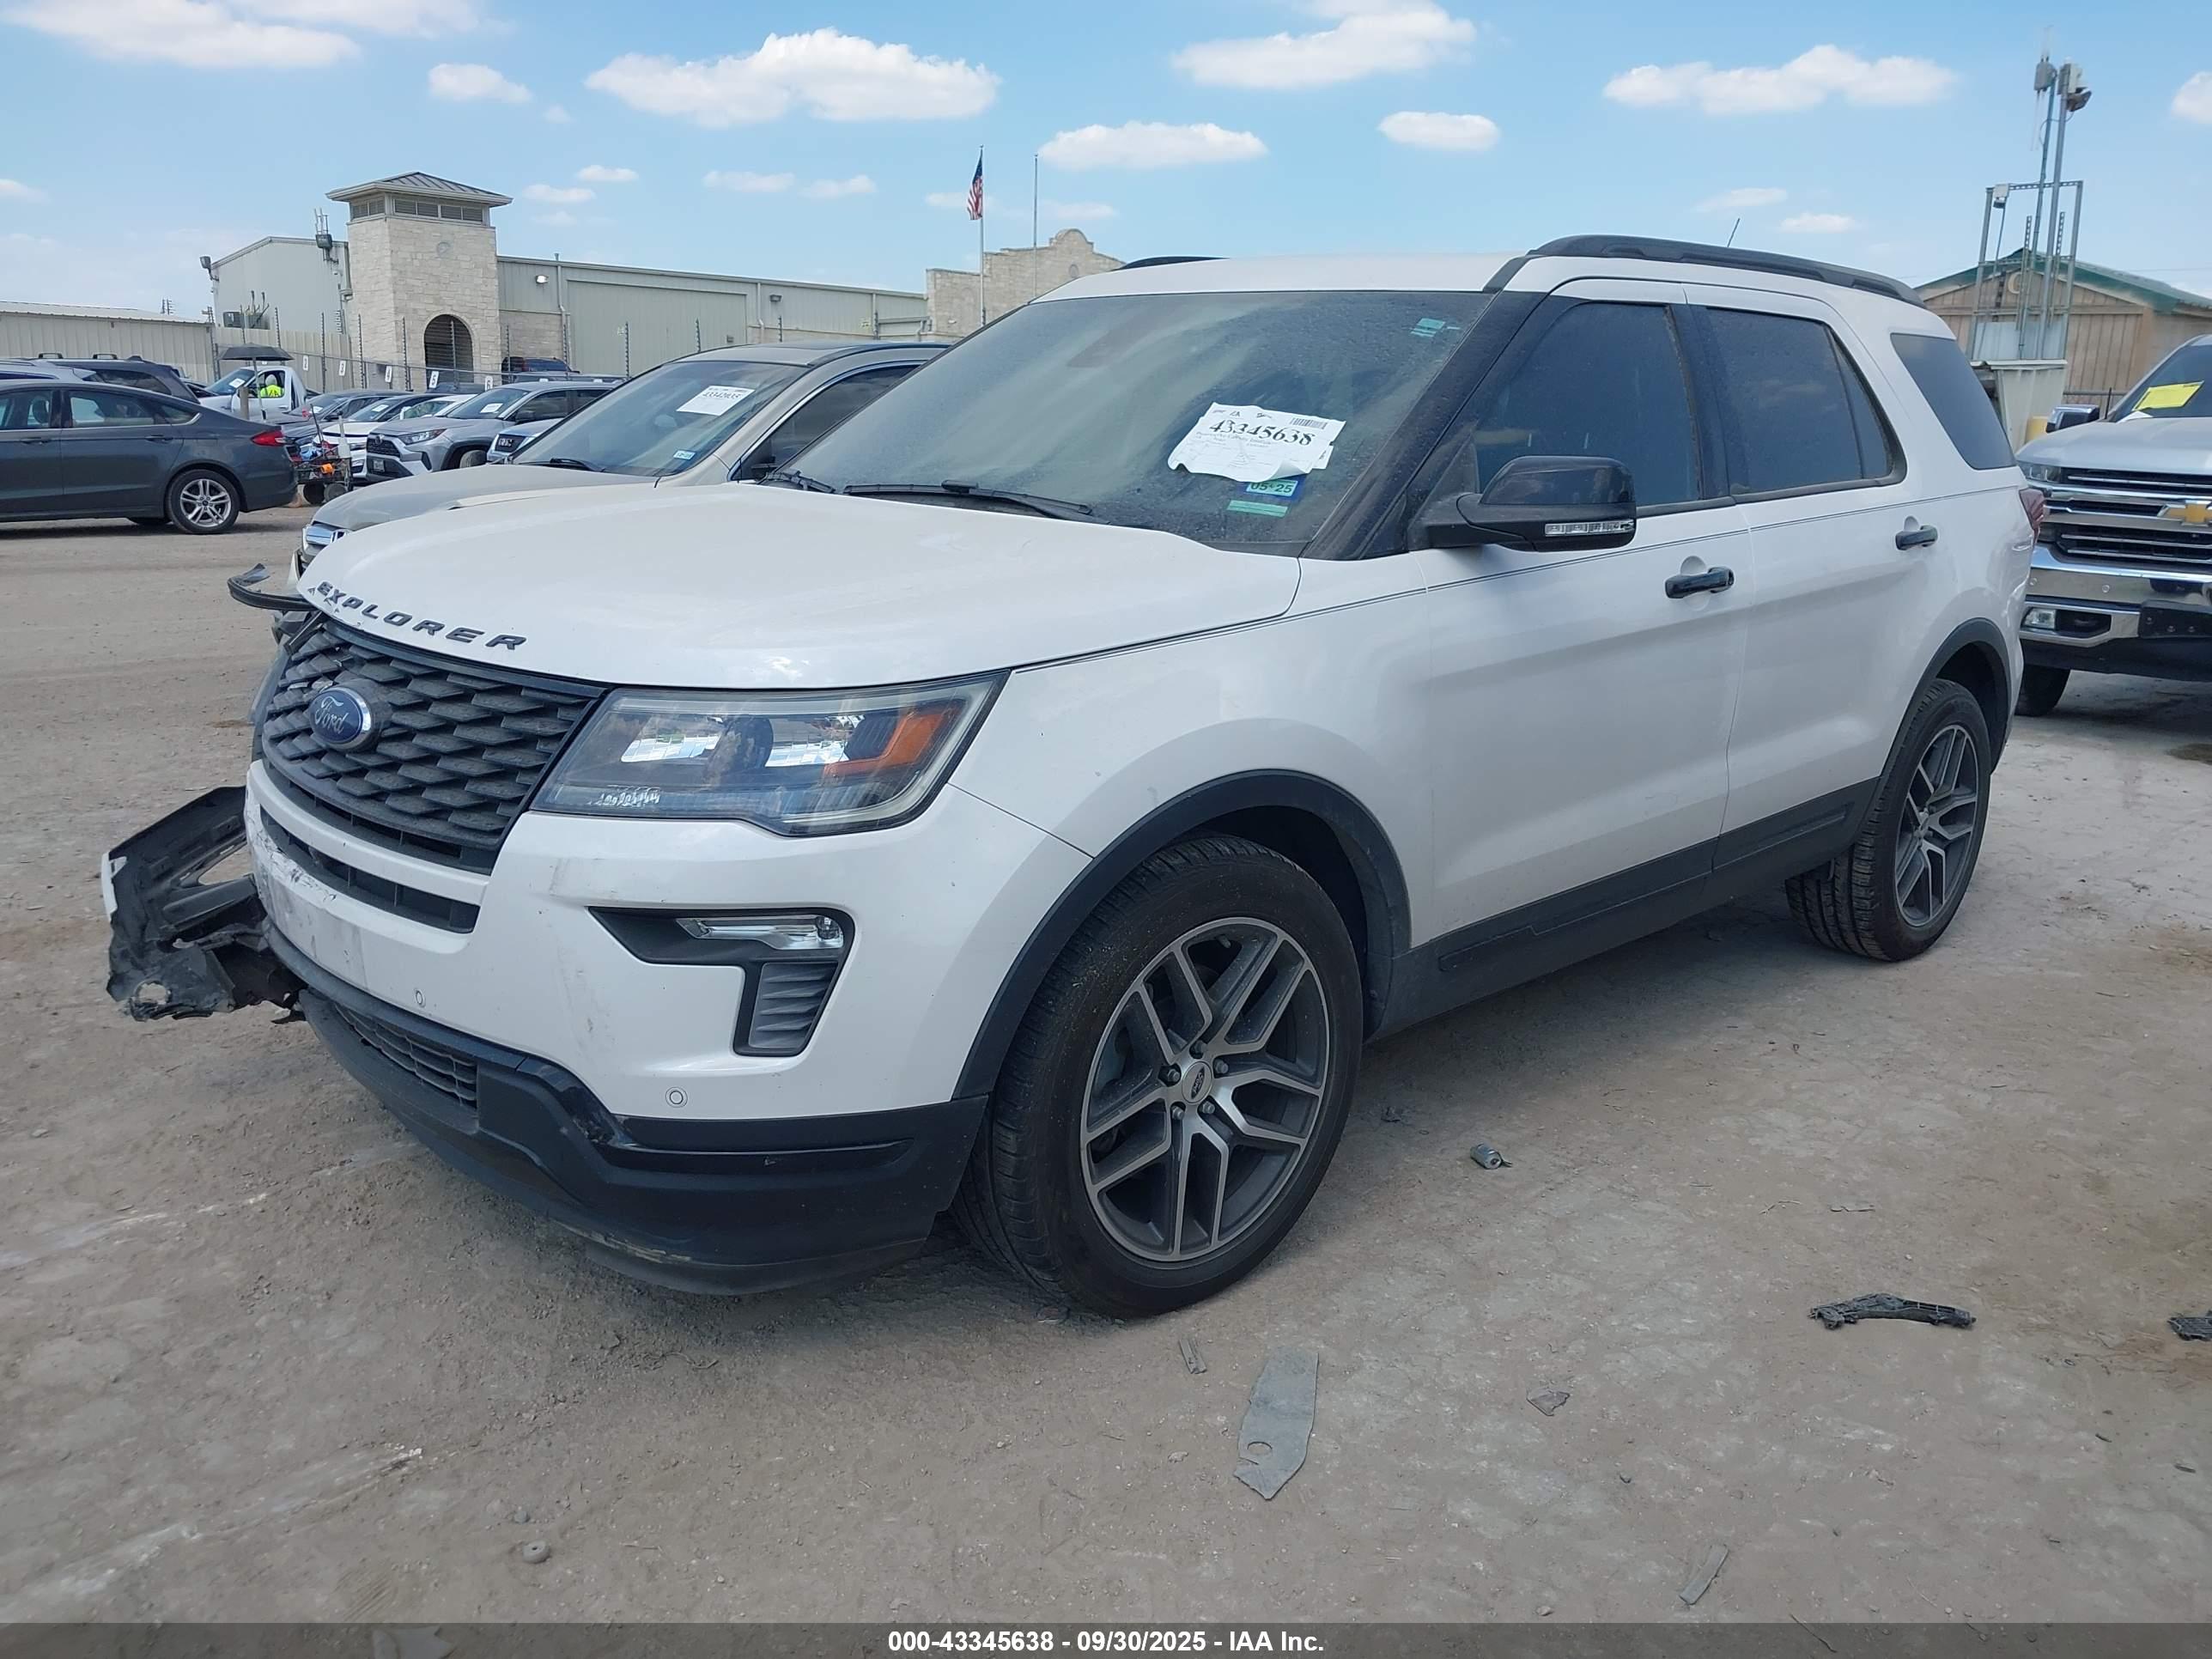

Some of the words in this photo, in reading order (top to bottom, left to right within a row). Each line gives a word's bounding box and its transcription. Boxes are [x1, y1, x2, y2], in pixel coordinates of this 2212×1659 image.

[431, 374, 437, 386] 5
[1209, 419, 1316, 446] 43345638
[1274, 483, 1294, 494] 25
[317, 581, 527, 651] EXPLORER
[314, 696, 348, 734] Ford
[1193, 1072, 1203, 1094] Ford
